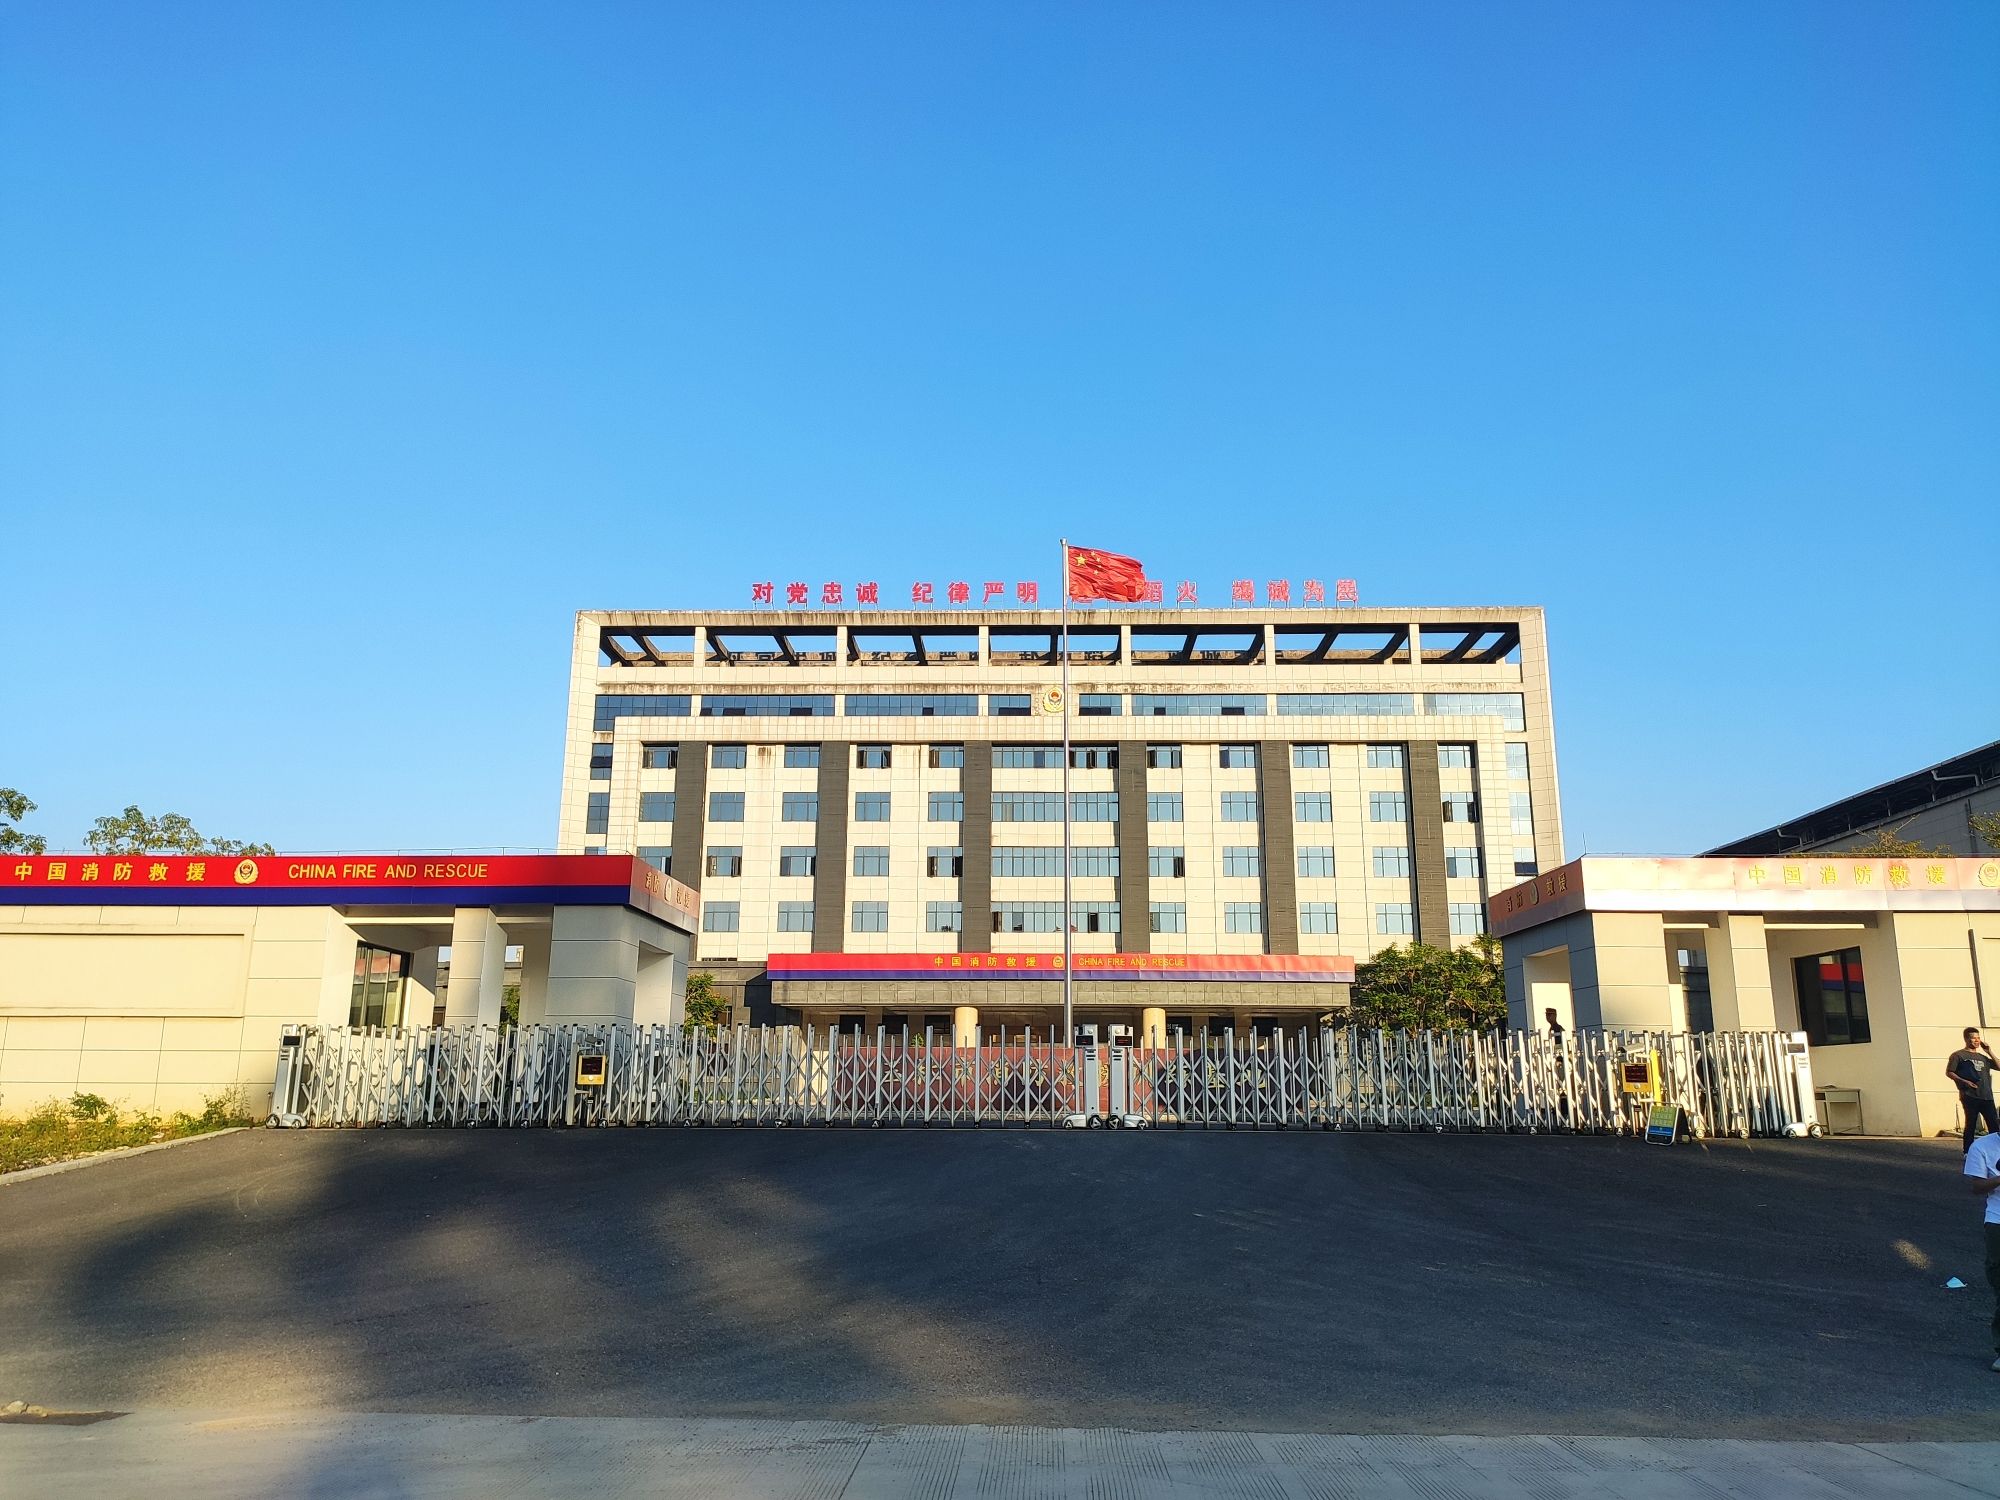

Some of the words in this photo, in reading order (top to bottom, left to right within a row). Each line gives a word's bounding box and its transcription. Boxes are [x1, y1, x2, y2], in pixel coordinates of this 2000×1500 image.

[752, 581, 879, 604] 对党忠诚
[911, 581, 1039, 604] 纪律严明
[14, 862, 206, 882] 中国消防救援
[288, 864, 337, 879] CHINA
[342, 864, 377, 879] FIRE
[384, 864, 417, 878] AND
[423, 863, 488, 878] RESCUE
[1748, 864, 1946, 885] 中国消防救援
[933, 956, 1037, 968] 中国消防救援
[1078, 957, 1104, 968] CHINA
[1107, 957, 1126, 967] FIRE
[1129, 957, 1148, 967] AND
[1151, 958, 1186, 968] RESCUE
